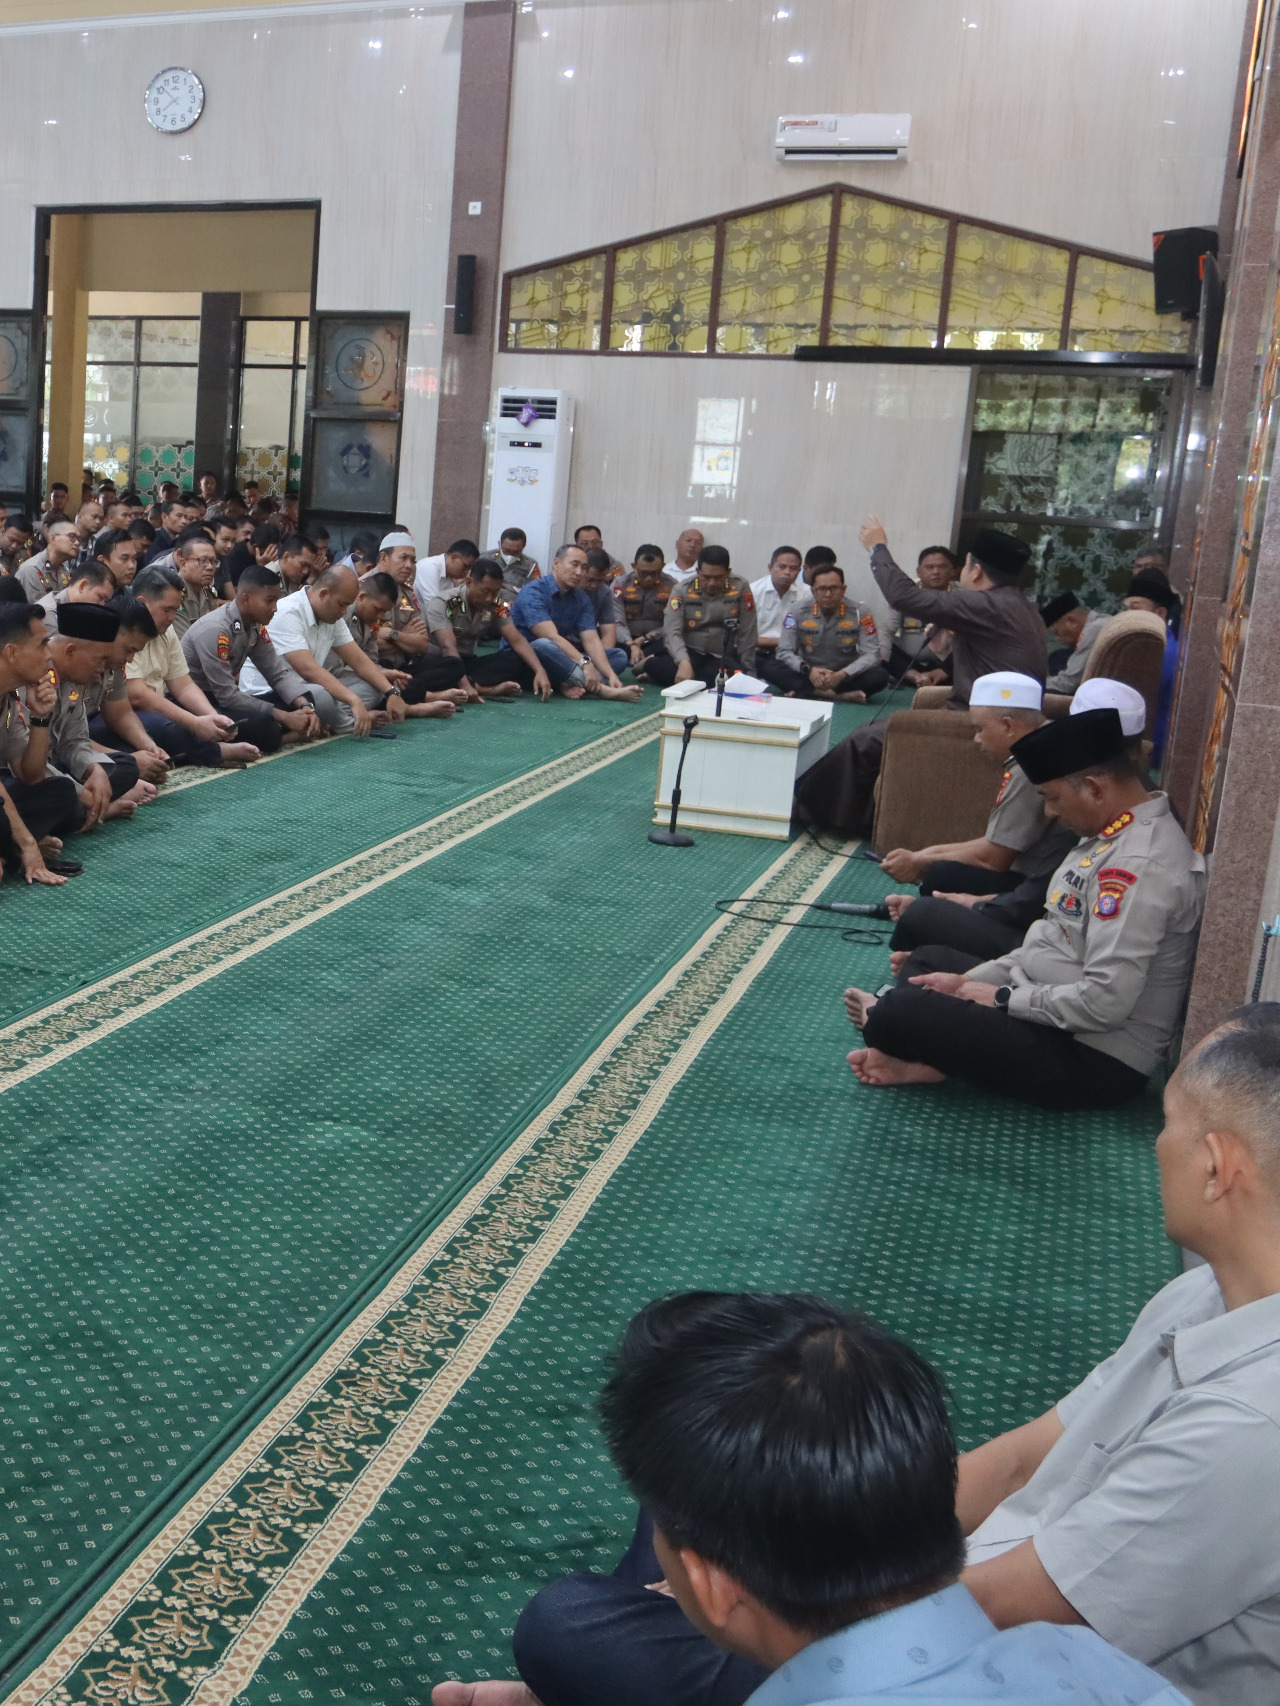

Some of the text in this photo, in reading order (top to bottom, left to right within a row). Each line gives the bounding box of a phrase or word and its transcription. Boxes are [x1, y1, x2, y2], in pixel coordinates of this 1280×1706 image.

[172, 75, 179, 83] 12
[156, 86, 164, 94] 10
[188, 85, 194, 93] 2
[153, 97, 159, 105] 9
[191, 95, 195, 103] 3
[155, 107, 160, 115] 8
[171, 117, 176, 125] 6
[180, 114, 186, 122] 5
